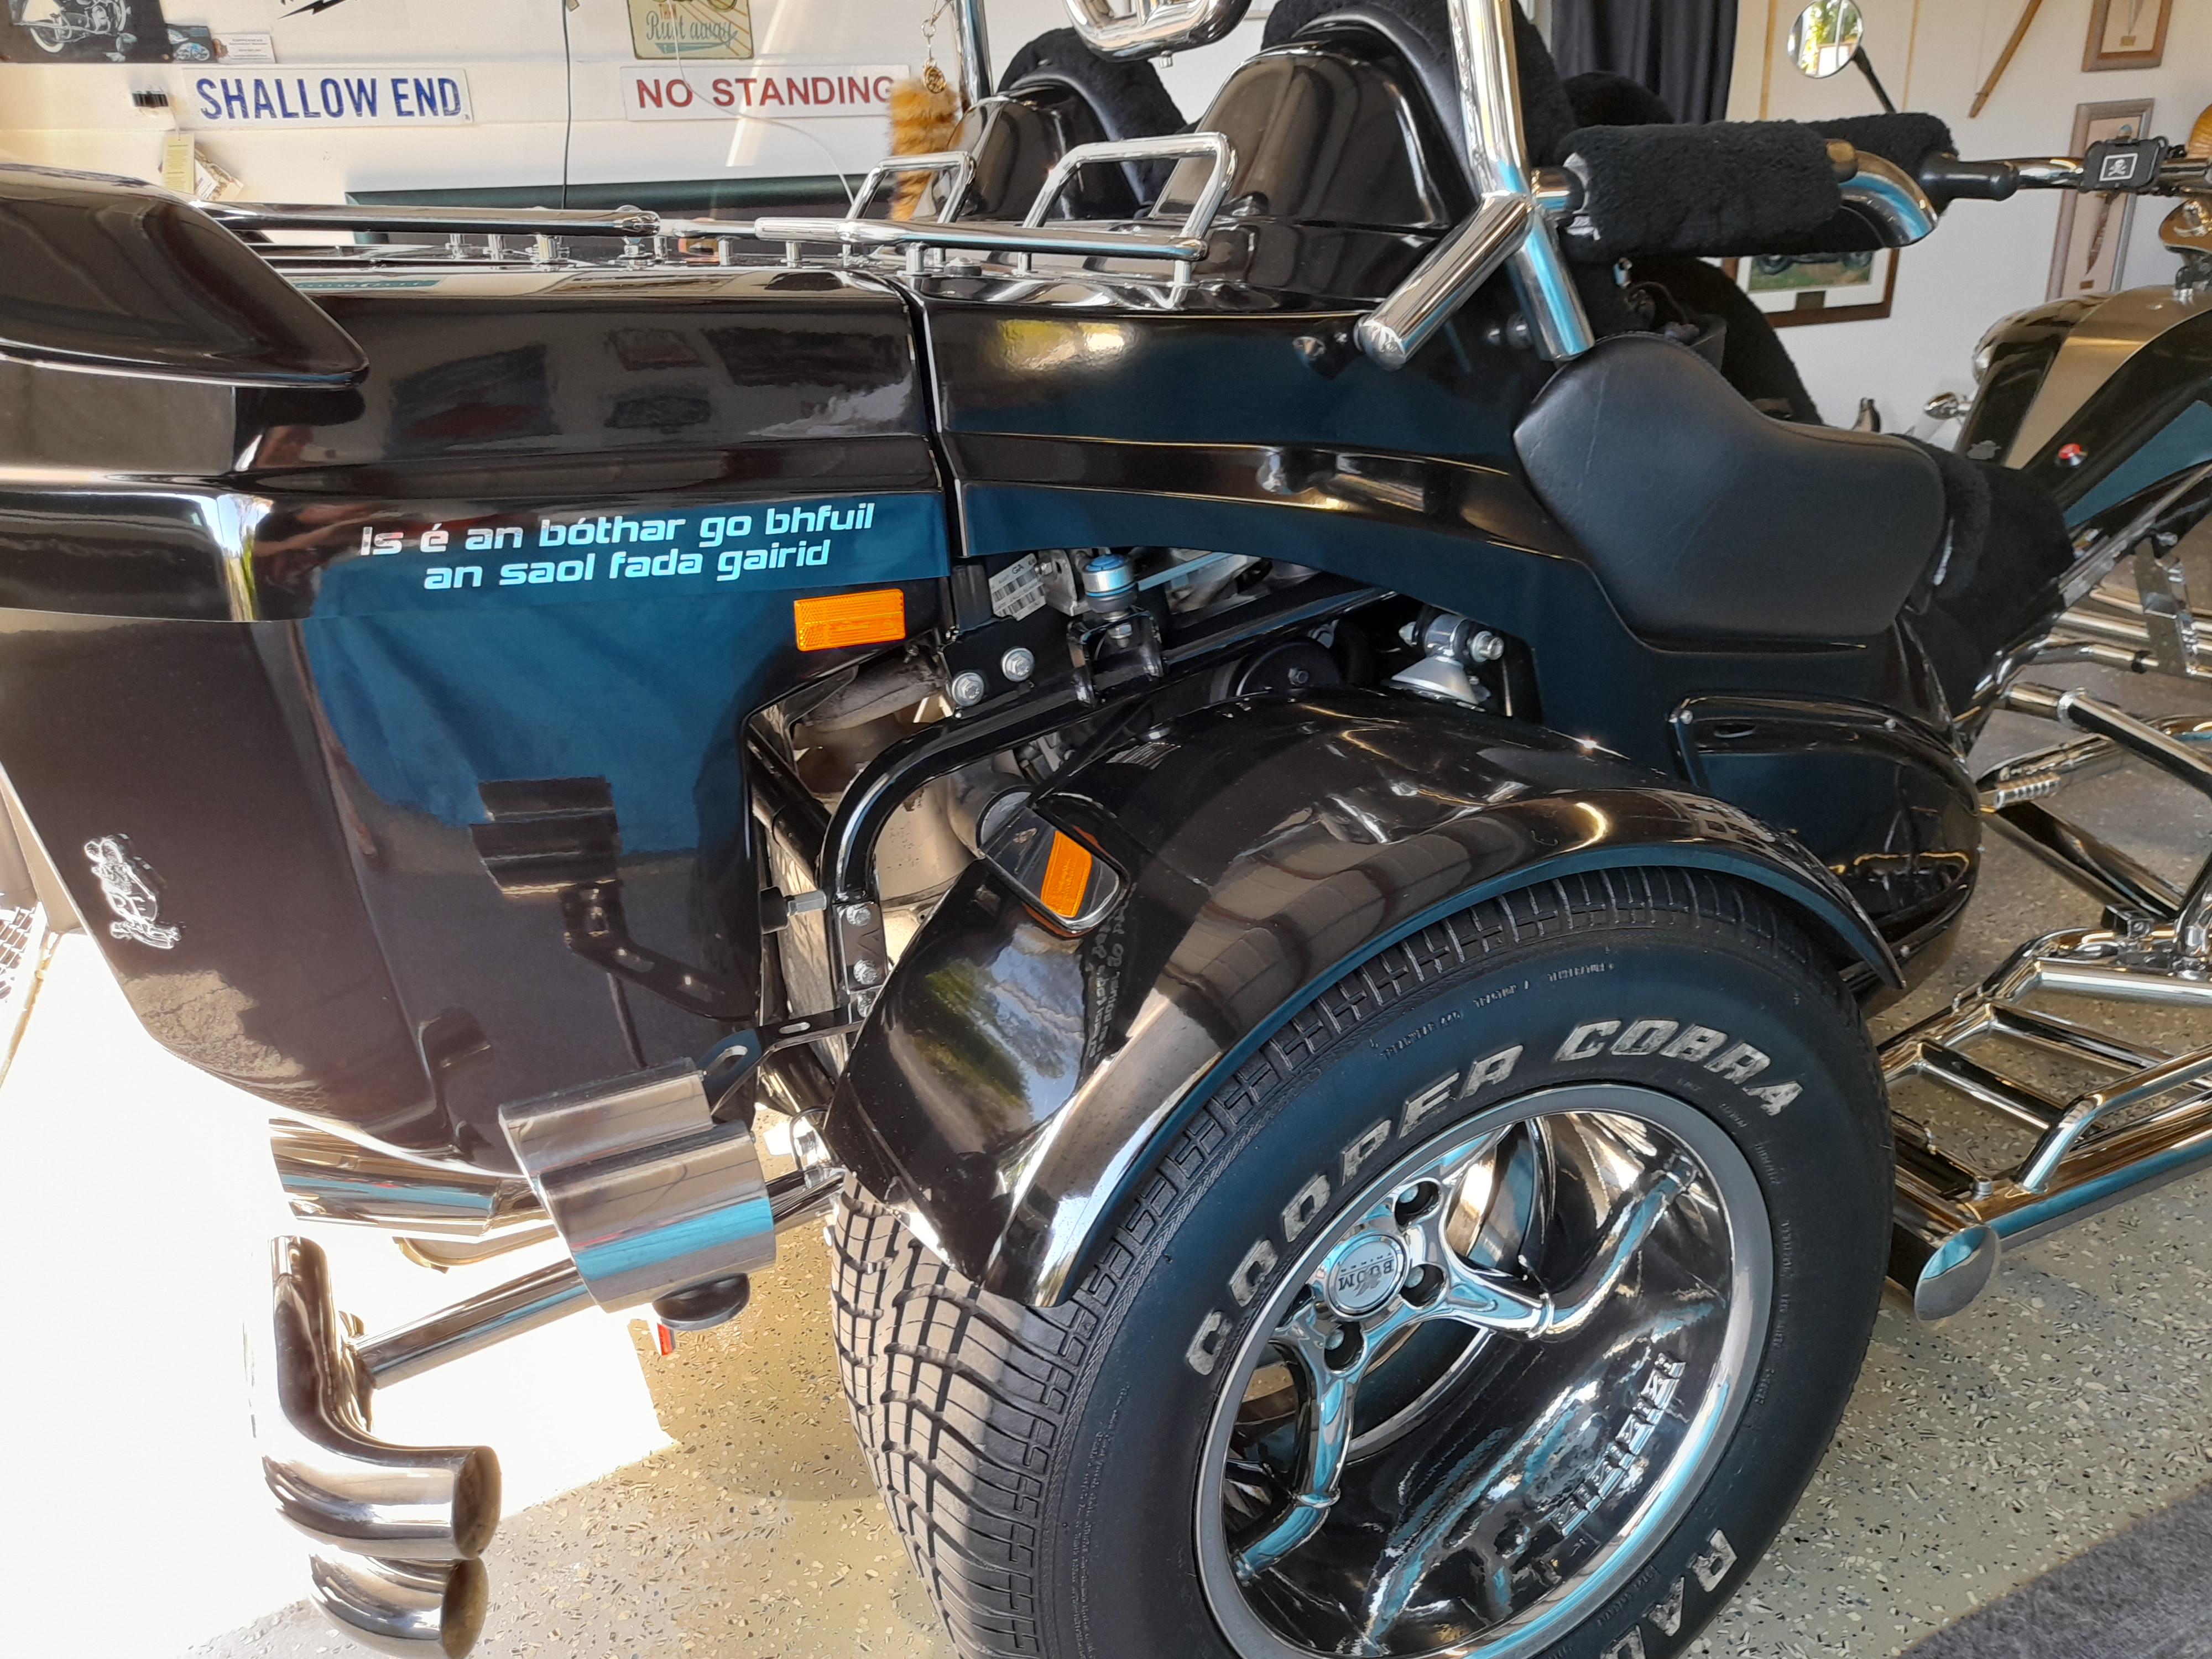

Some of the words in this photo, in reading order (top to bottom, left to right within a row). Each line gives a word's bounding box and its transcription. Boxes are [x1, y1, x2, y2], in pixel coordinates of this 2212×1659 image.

[196, 77, 378, 120] SHALLOW
[390, 77, 462, 117] END
[637, 79, 693, 108] NO
[713, 76, 894, 107] STANDING
[360, 526, 404, 556] Is
[420, 523, 449, 552] é
[465, 527, 524, 550] an
[539, 514, 686, 547] bóthar
[698, 515, 752, 547] go
[765, 503, 875, 535] bhfuil
[424, 566, 483, 589] an
[499, 552, 596, 586] saol
[609, 548, 703, 579] fada
[716, 539, 832, 582] gairid
[1186, 1044, 1524, 1376] COOPER
[1553, 1019, 1804, 1117] COBRA
